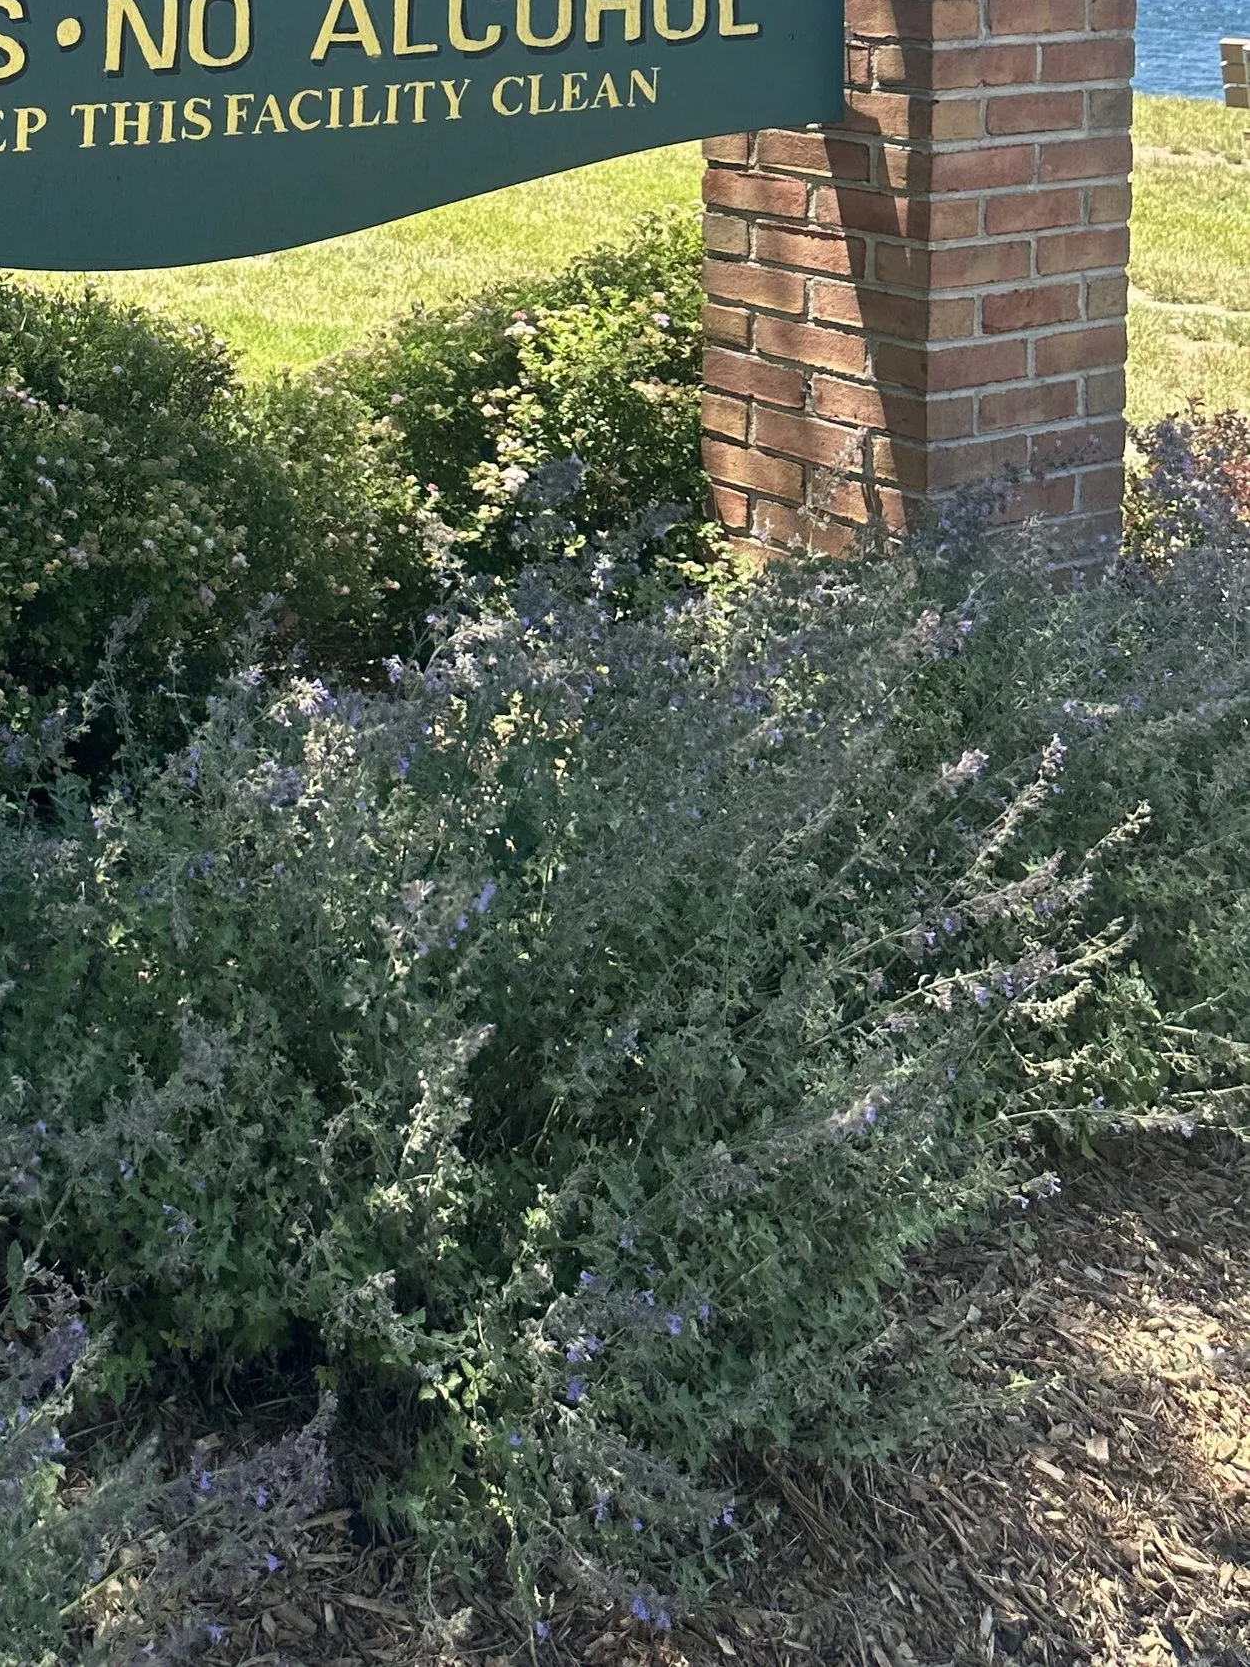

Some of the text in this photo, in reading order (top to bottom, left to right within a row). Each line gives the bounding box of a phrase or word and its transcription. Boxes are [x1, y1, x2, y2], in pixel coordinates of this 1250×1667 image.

[70, 98, 212, 149] THIS
[223, 77, 472, 136] FACILITY
[490, 67, 662, 117] CLEAN
